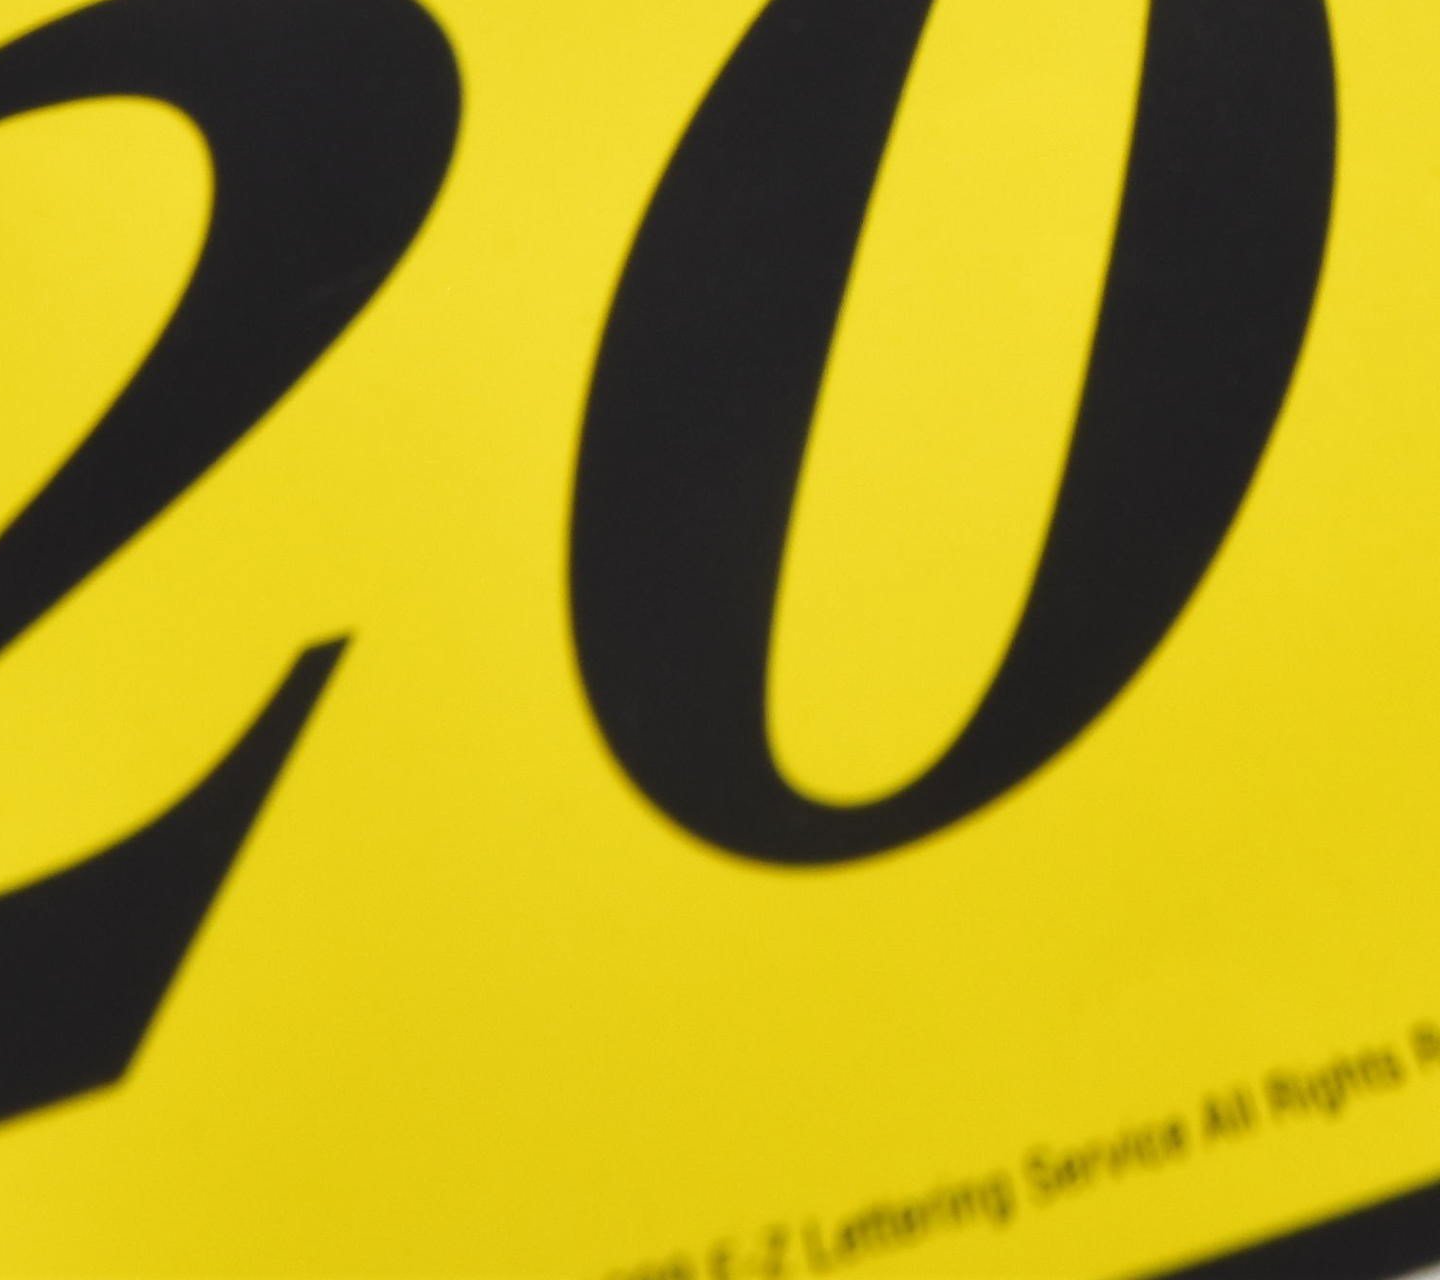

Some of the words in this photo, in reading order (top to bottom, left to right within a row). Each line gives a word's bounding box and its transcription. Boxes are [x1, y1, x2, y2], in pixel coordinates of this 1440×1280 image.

[800, 1167, 1019, 1278] Lettering
[1021, 1110, 1192, 1200] Service
[1199, 1078, 1262, 1152] All
[1262, 1040, 1408, 1125] Rights
